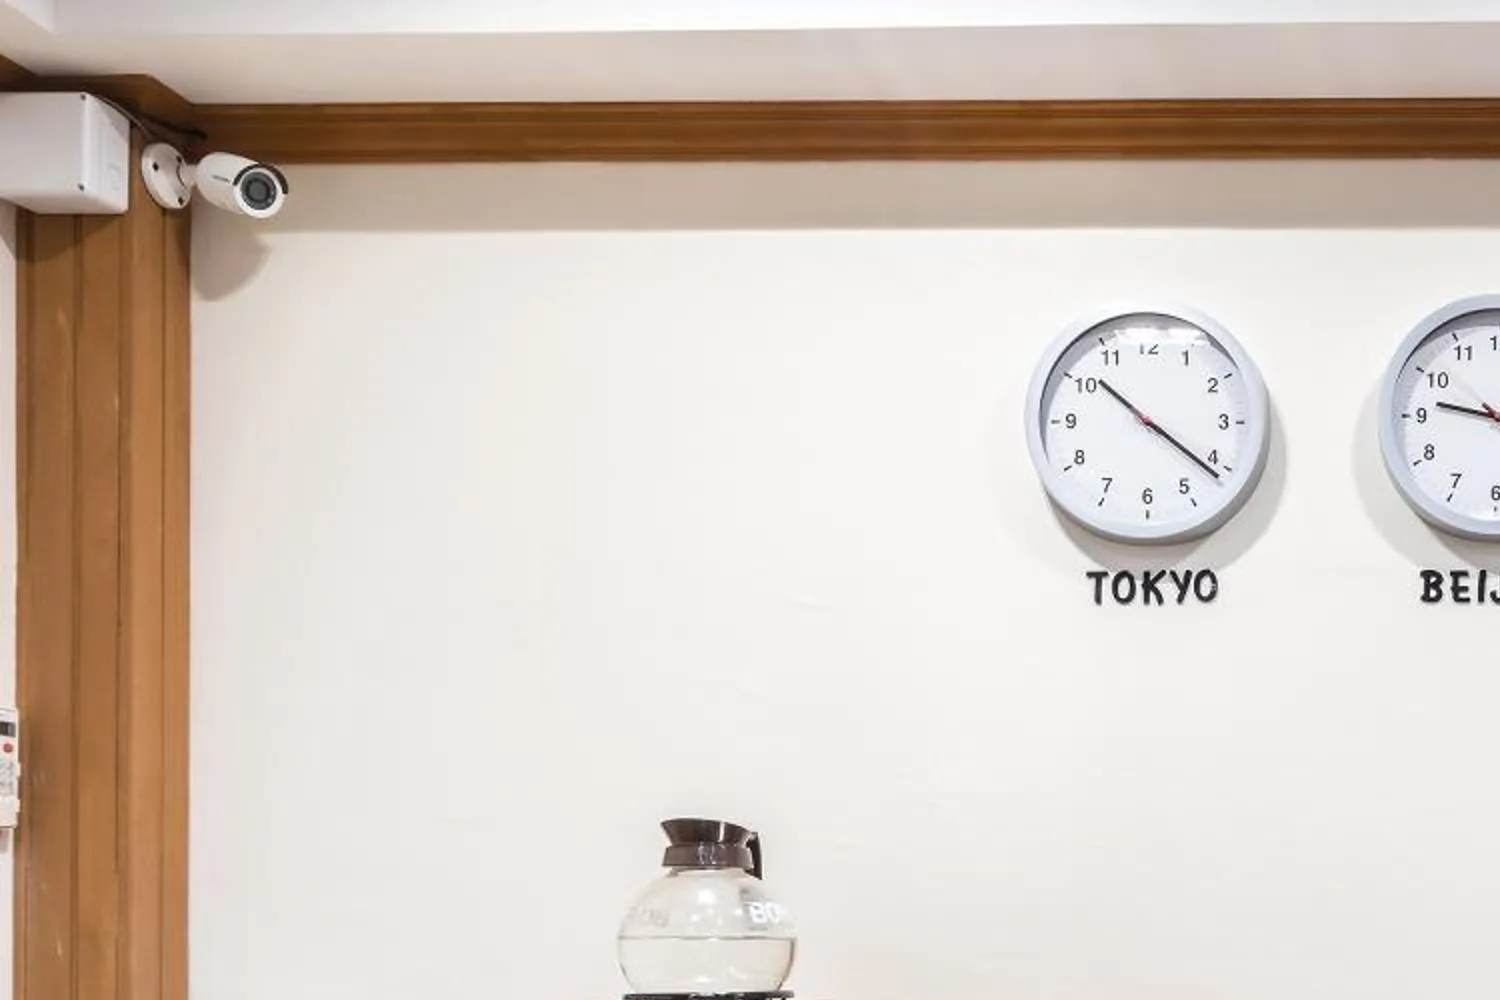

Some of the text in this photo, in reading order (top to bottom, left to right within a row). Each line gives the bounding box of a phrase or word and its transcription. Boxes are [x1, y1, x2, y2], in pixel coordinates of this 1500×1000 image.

[1100, 349, 1120, 367] 11
[1181, 349, 1190, 367] 1
[1453, 344, 1473, 361] 11
[1073, 376, 1098, 395] 10
[1207, 376, 1219, 394] 2
[1426, 370, 1450, 390] 10
[1064, 412, 1078, 430] 9
[1217, 412, 1230, 431] 3
[1415, 406, 1428, 425] 9
[1073, 448, 1086, 467] 8
[1206, 448, 1220, 466] 4
[1423, 442, 1436, 462] 8
[1100, 476, 1113, 495] 7
[1178, 477, 1191, 496] 5
[1449, 472, 1463, 489] 7
[1141, 487, 1154, 506] 6
[1085, 568, 1219, 606] TOKYO
